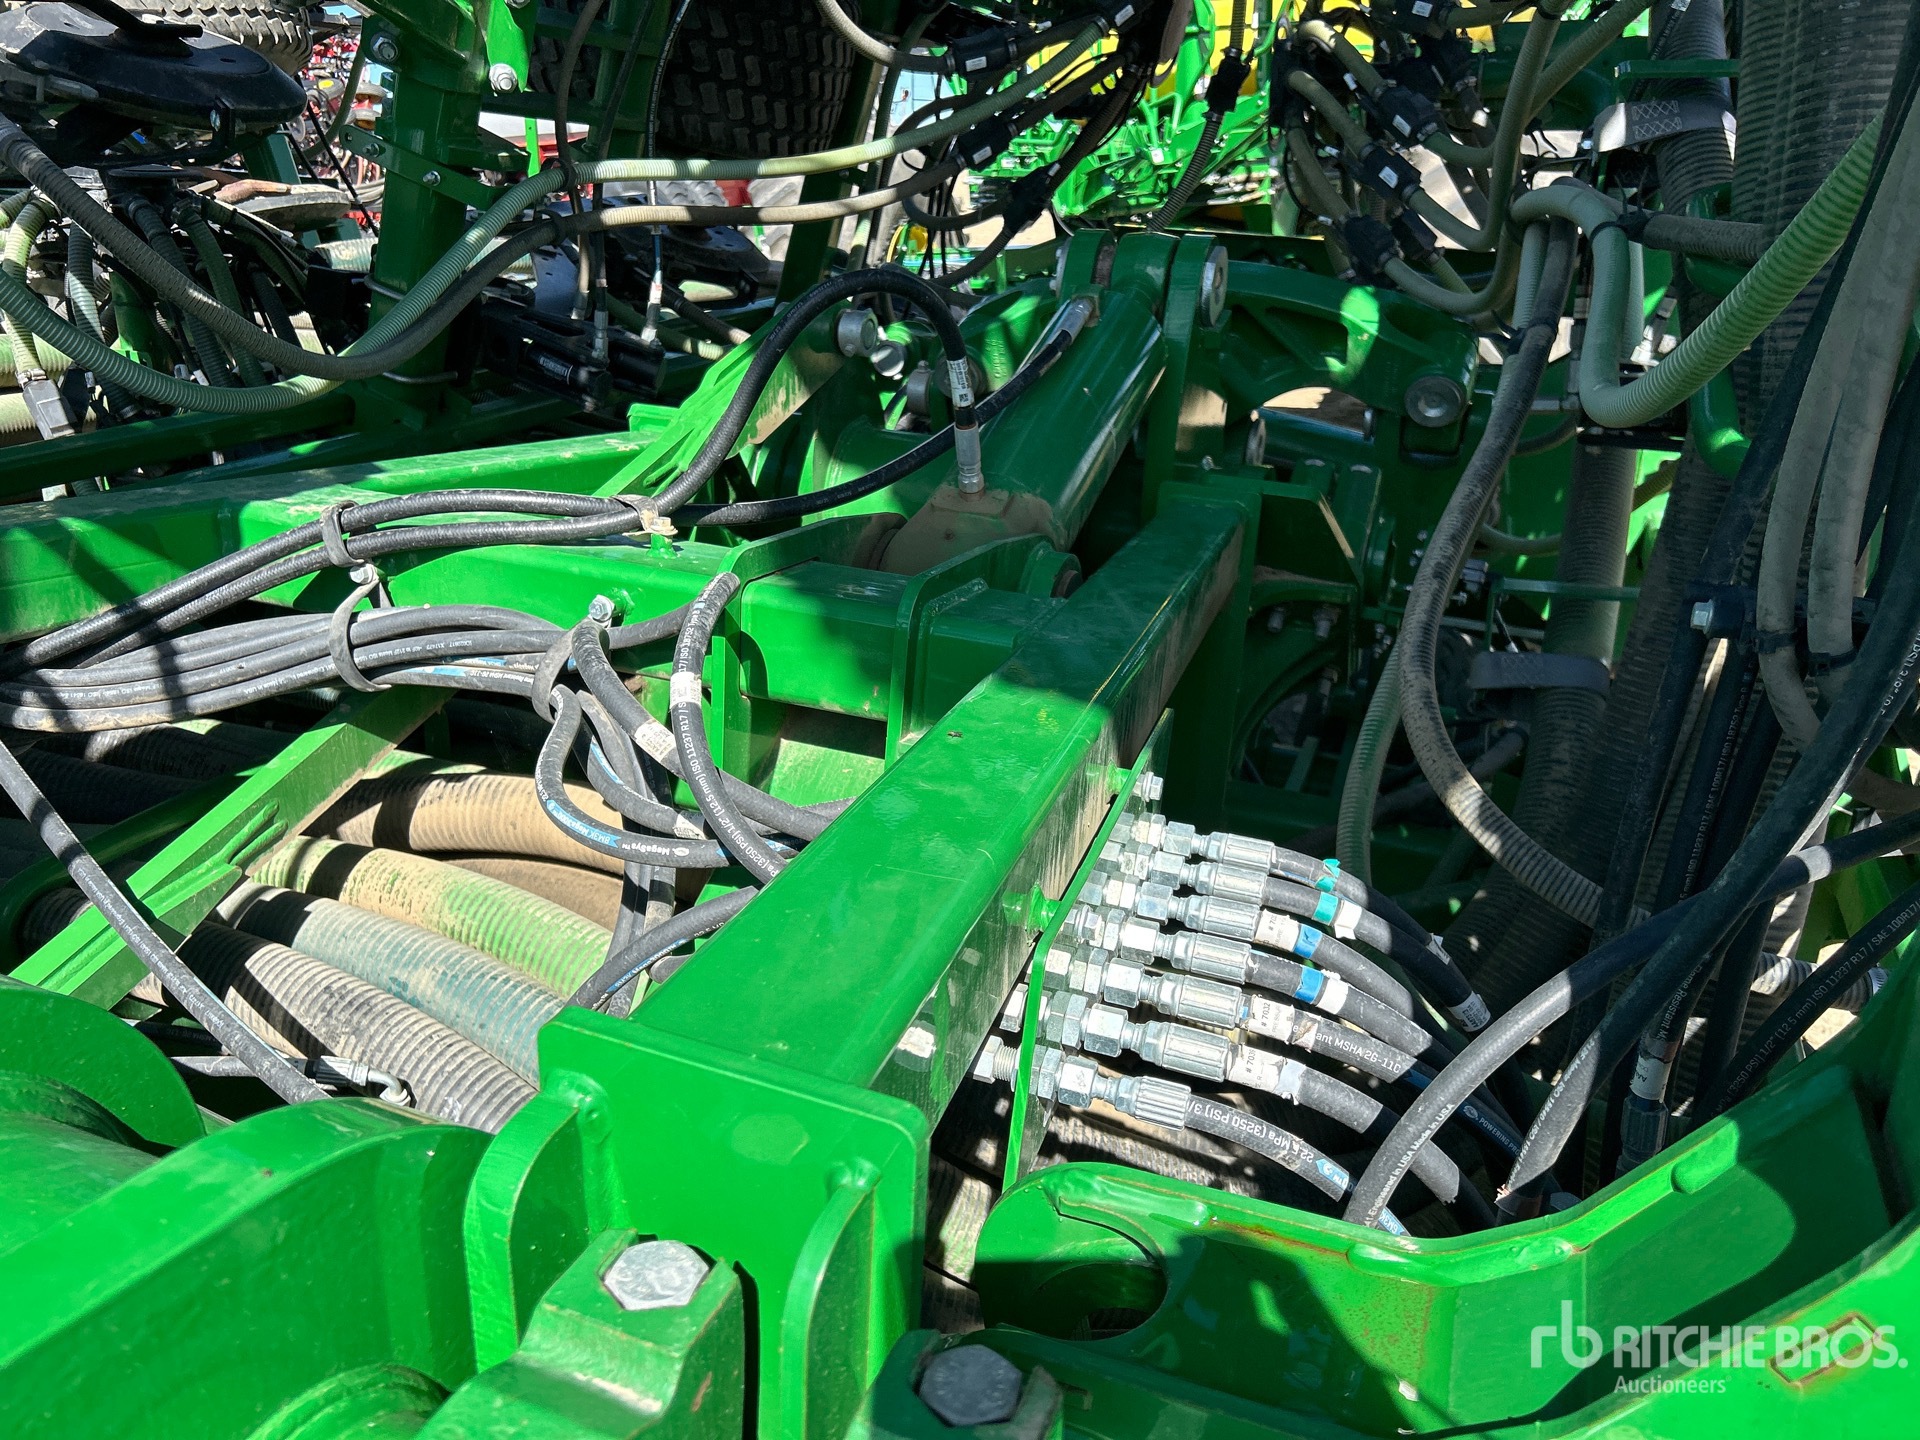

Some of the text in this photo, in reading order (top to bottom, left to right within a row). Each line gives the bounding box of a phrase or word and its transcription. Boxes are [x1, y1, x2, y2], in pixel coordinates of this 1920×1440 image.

[680, 647, 689, 659] ISO
[678, 715, 690, 732] R17
[682, 732, 697, 760] 11237
[690, 759, 702, 775] ISO
[696, 774, 711, 795] mm)
[706, 794, 726, 819] (12.5
[746, 847, 771, 869] (3250
[1812, 983, 1830, 1003] ISO
[1823, 959, 1853, 991] 11237
[1849, 947, 1869, 967] R17
[1870, 927, 1891, 948] SAE
[1262, 1003, 1270, 1019] 7032
[1661, 988, 1688, 1030] Resistant
[1333, 1038, 1363, 1057] MSHA
[1203, 1104, 1230, 1122] PSI)
[1231, 1115, 1267, 1138] (3250
[1478, 1117, 1510, 1146] POWERING
[1267, 1131, 1290, 1149] MPa
[1369, 1175, 1398, 1216] Engineered
[1397, 1149, 1415, 1169] USA
[1411, 1128, 1432, 1151] Made
[1435, 1102, 1455, 1122] USA
